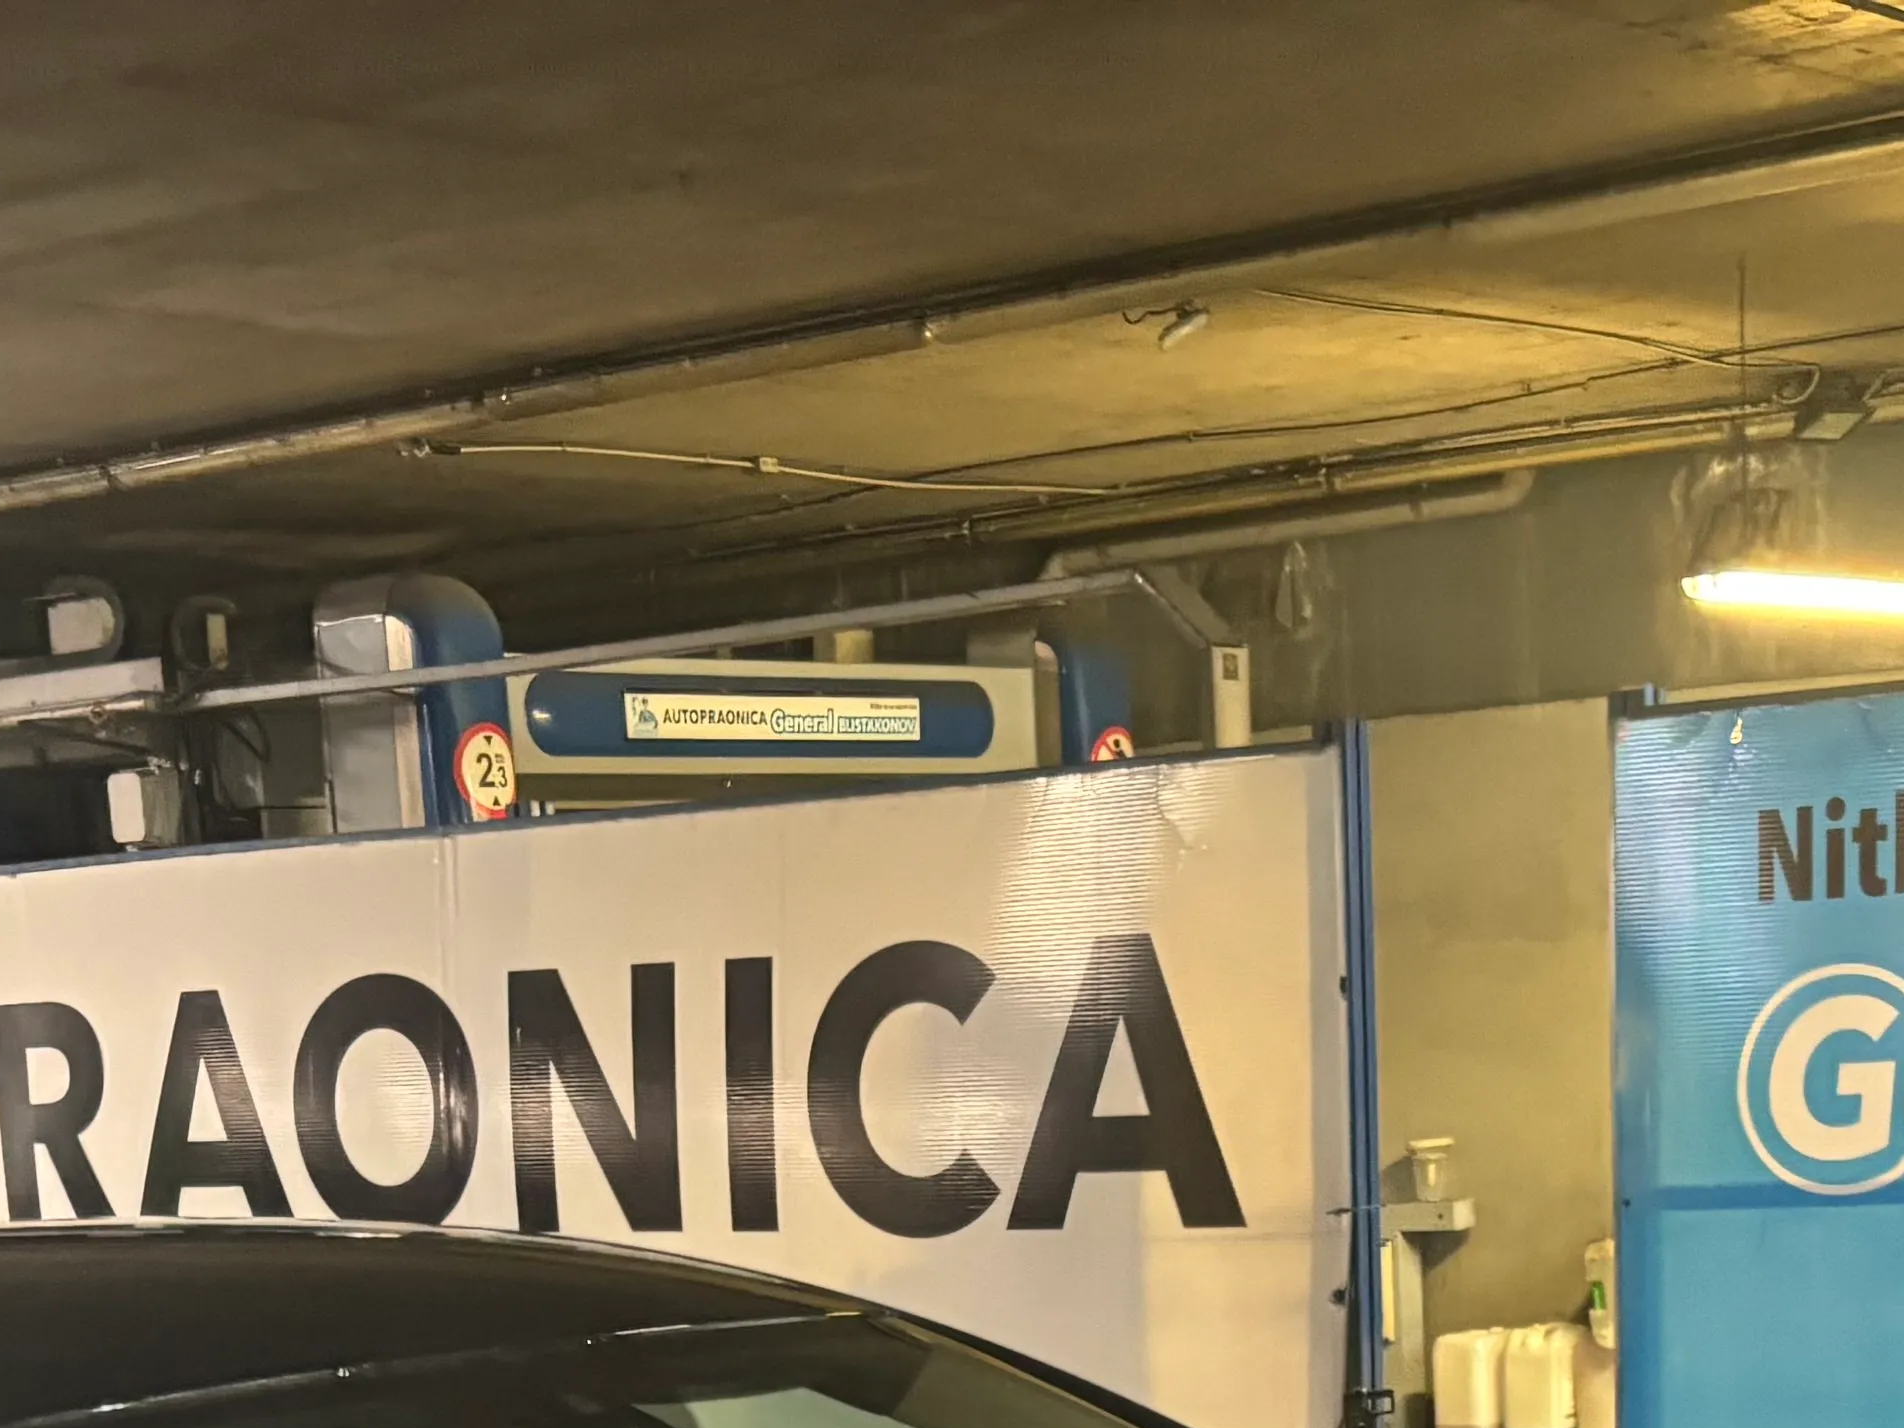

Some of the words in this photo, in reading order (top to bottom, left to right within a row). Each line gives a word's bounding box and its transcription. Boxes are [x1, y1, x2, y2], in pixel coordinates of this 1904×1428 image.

[663, 708, 767, 725] AUTOPRAONICA
[770, 708, 834, 734] General
[837, 716, 916, 734] BLISTAKONOV
